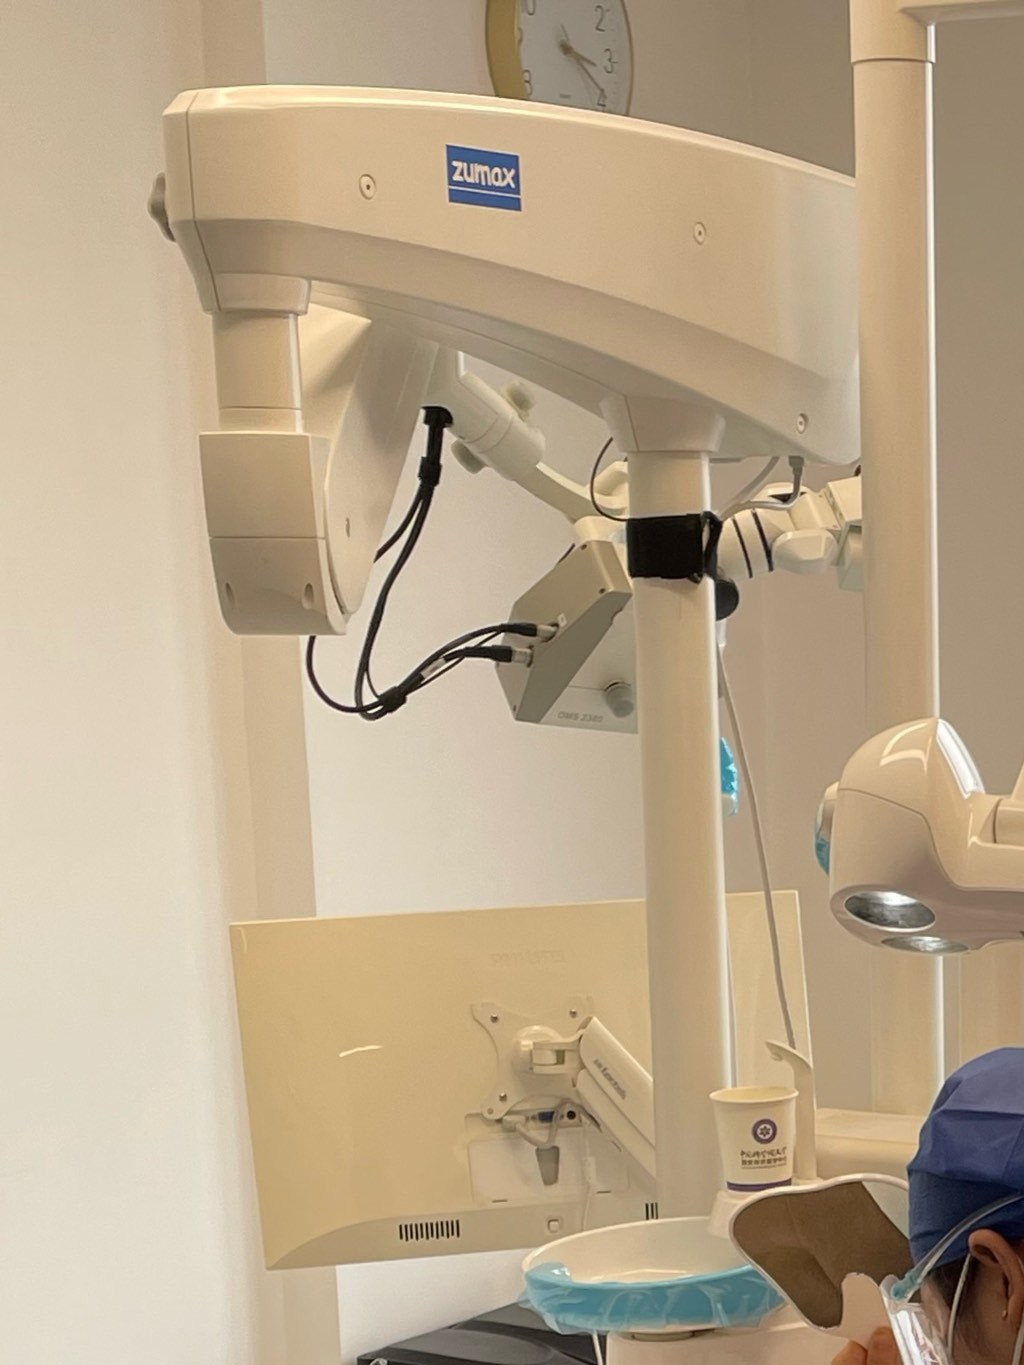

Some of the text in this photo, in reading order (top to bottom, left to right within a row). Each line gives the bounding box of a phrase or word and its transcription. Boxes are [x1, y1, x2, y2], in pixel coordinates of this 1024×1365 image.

[594, 5, 605, 32] 2
[603, 48, 613, 74] 3
[451, 160, 516, 189] zumax
